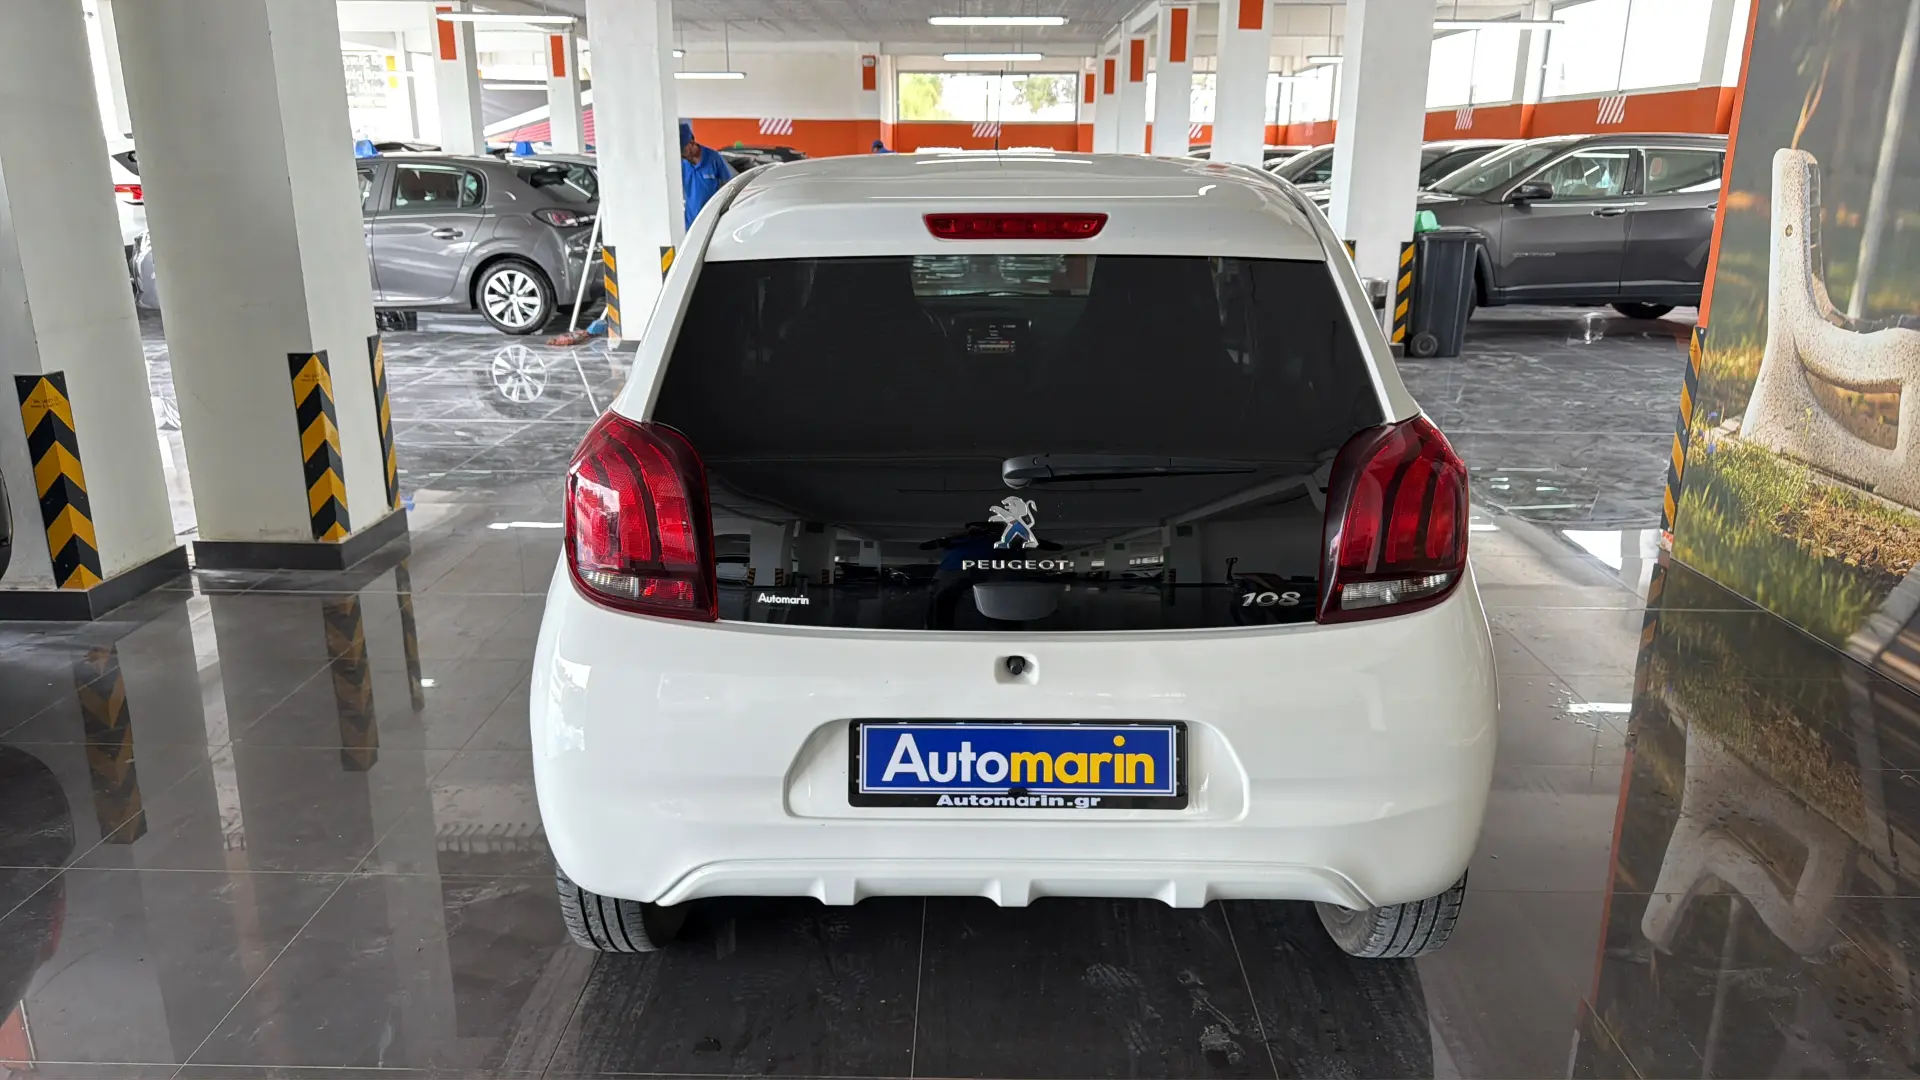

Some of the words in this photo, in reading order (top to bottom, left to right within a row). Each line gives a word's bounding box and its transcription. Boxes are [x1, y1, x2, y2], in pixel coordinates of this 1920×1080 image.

[962, 560, 1069, 570] PEUGEOT
[757, 592, 810, 605] Automarin
[1242, 591, 1301, 607] 108
[881, 733, 1154, 784] Automarin
[936, 794, 1101, 808] Automarin.gr
